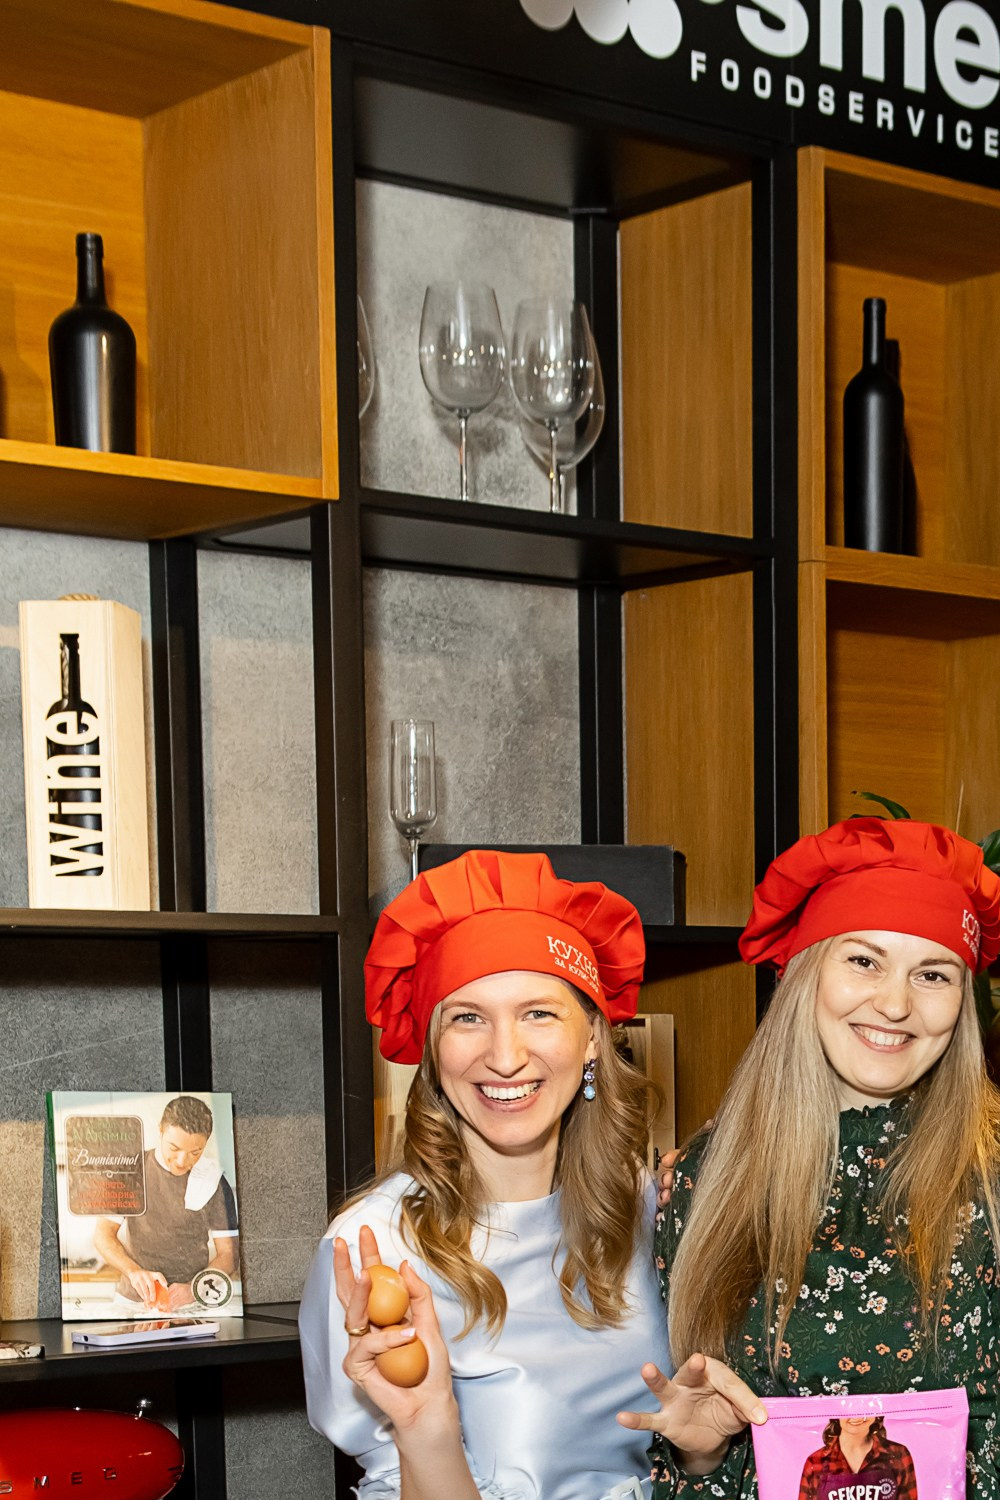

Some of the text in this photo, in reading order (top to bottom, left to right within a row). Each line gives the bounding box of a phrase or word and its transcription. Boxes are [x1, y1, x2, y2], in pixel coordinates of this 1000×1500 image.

[690, 50, 1000, 158] FOODSERVICE
[45, 710, 104, 877] wine
[546, 935, 600, 987] КУХНЯ
[554, 956, 566, 969] ЗА
